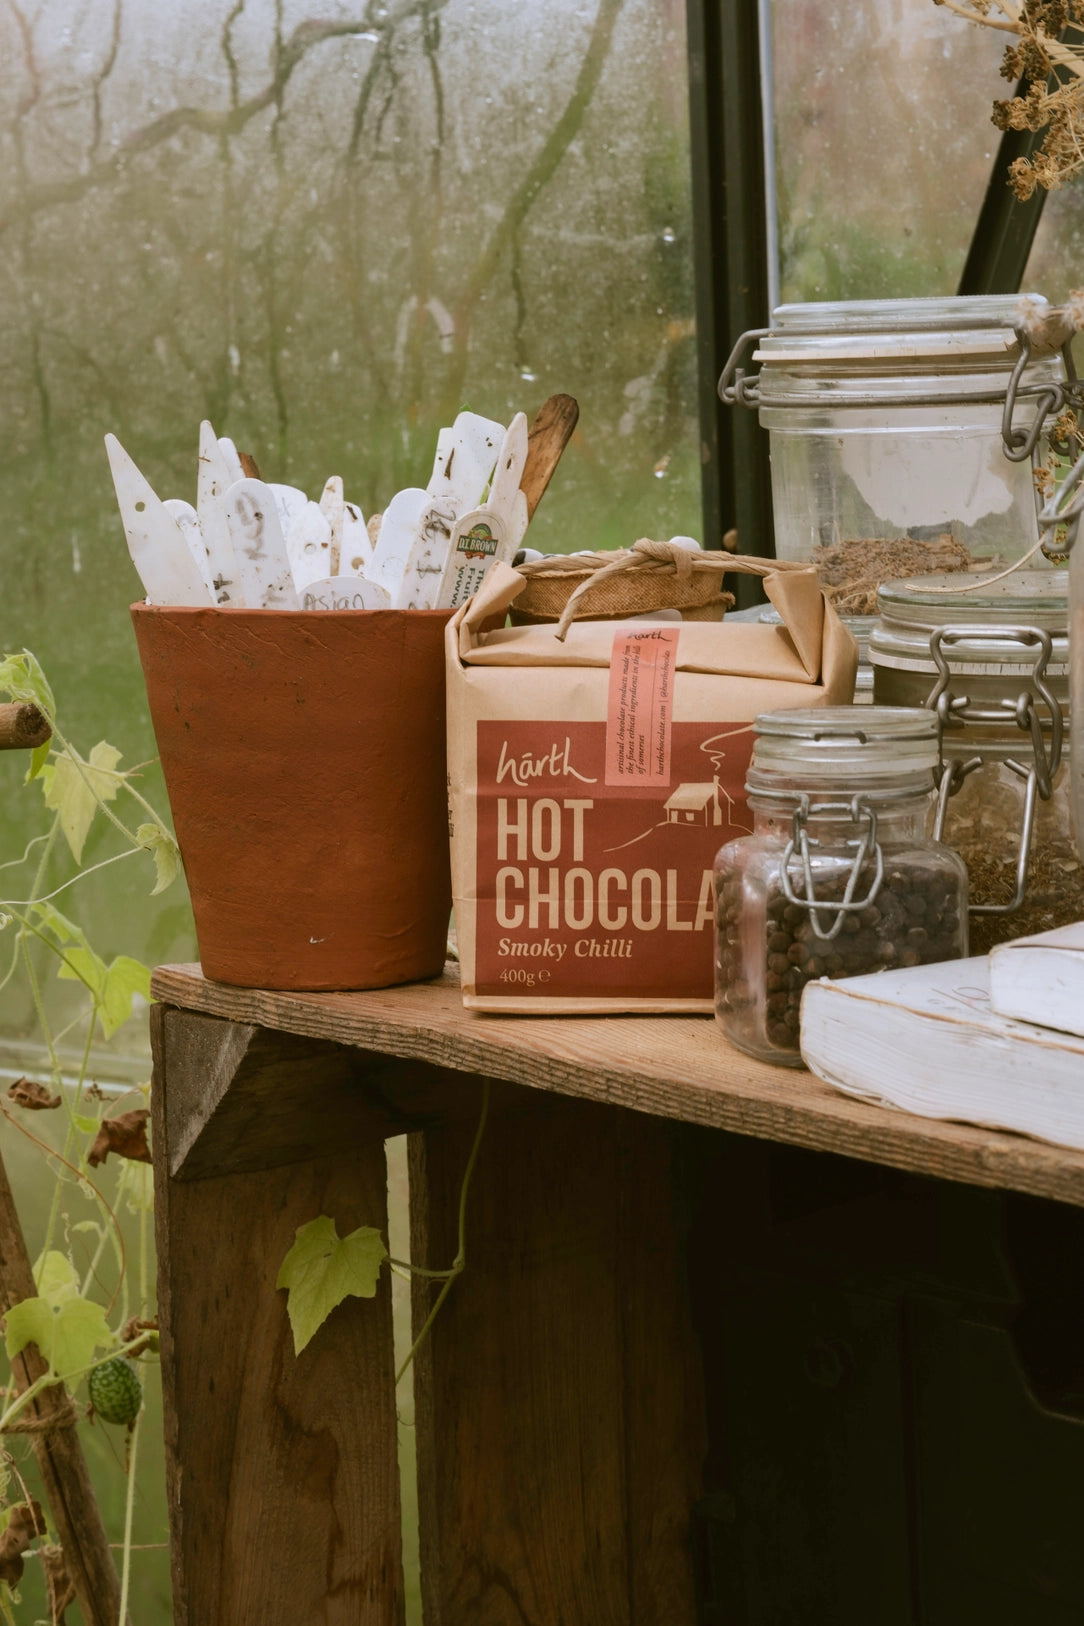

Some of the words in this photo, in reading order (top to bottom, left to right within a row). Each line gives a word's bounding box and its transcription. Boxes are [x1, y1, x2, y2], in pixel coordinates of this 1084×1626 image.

[470, 538, 497, 552] BROWN
[462, 567, 476, 601] Fruit
[622, 658, 630, 674] made
[619, 676, 629, 706] products
[616, 707, 626, 740] chocolate
[627, 713, 636, 739] ethical
[625, 741, 637, 762] finest
[626, 762, 635, 774] the
[635, 765, 646, 775] of
[497, 798, 594, 861] HOT
[497, 938, 568, 962] Smoky
[574, 939, 633, 958] Chilli
[499, 968, 536, 986] 400g
